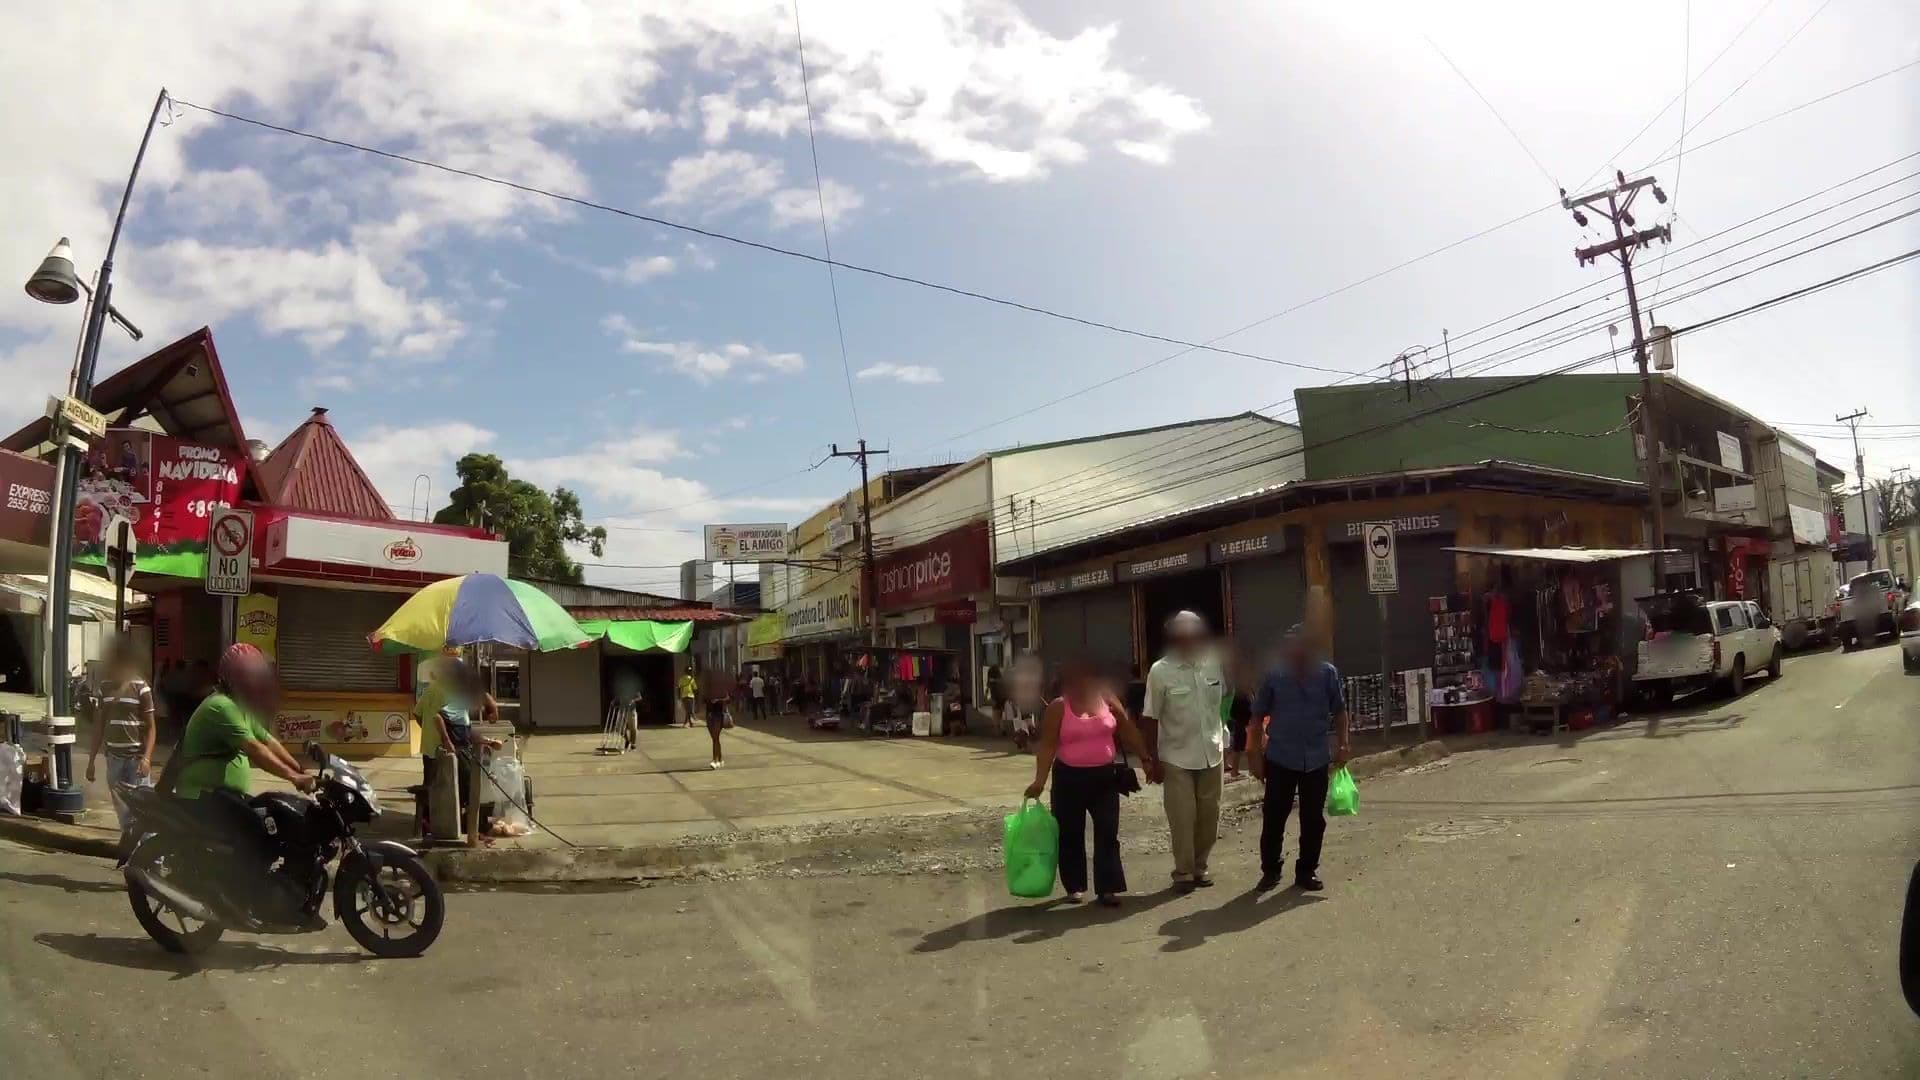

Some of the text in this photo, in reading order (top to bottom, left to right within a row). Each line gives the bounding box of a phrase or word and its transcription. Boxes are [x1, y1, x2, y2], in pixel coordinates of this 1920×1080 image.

[178, 446, 220, 461] PROMO
[9, 483, 51, 503] EXPRESS
[740, 539, 784, 551] EL AMIGO
[1229, 536, 1268, 554] DETALLE
[219, 558, 239, 576] NO
[827, 593, 849, 622] AMIGO
